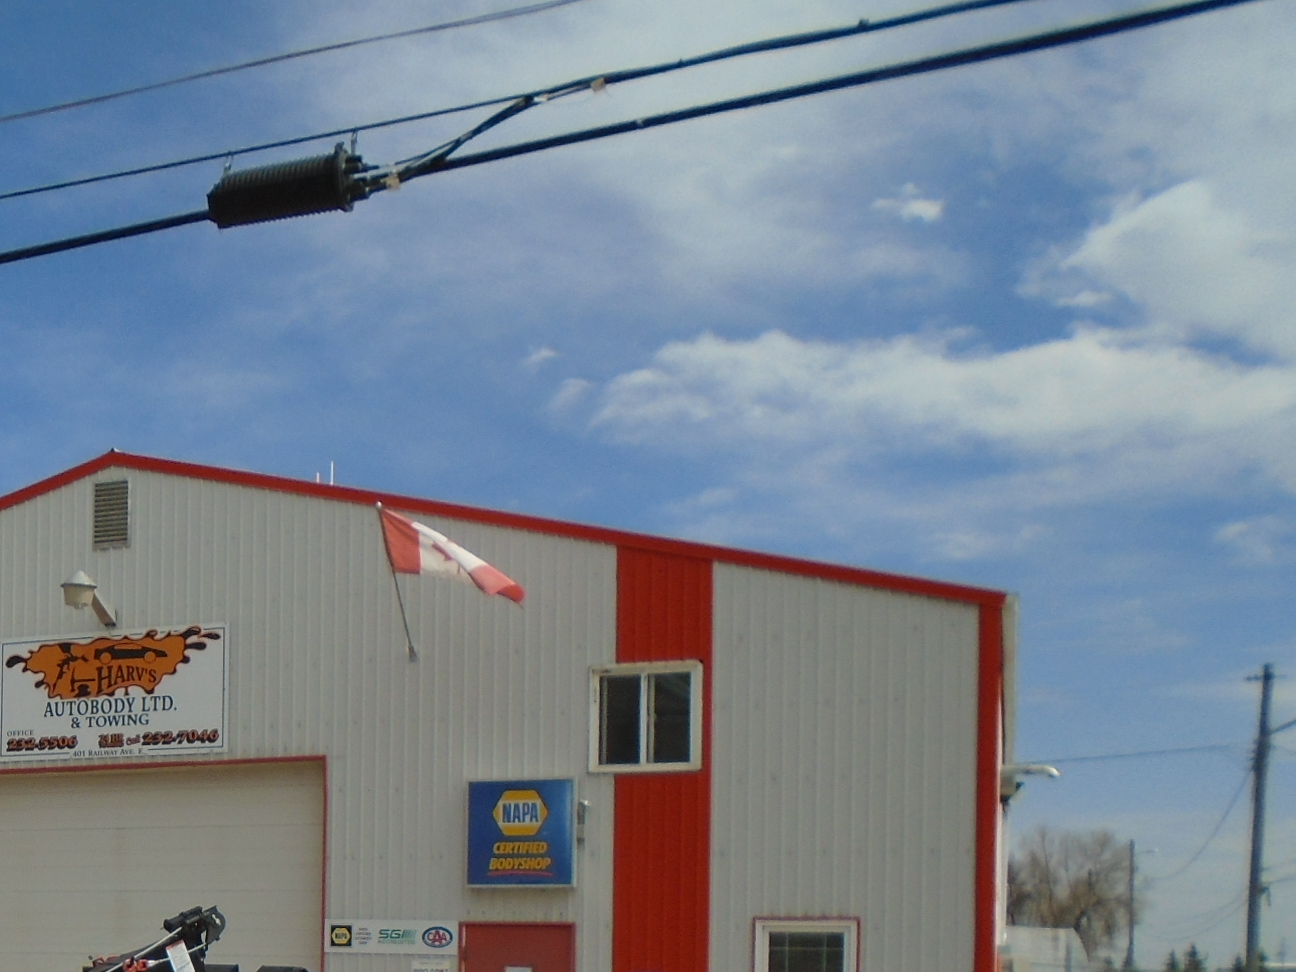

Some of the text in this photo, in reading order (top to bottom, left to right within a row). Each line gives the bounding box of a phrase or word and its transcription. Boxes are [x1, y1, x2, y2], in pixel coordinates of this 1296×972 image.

[96, 665, 157, 695] HARV'S
[43, 695, 177, 718] AUTOBODY LTD.
[70, 713, 150, 729] & TOWING
[6, 729, 34, 737] OFFICE
[141, 728, 220, 746] 232-7046
[88, 749, 117, 757] RAILWAY
[502, 802, 539, 823] NAPA
[493, 842, 547, 854] CERTIFIED
[489, 857, 551, 869] BODYSHOP
[427, 930, 447, 944] CAA
